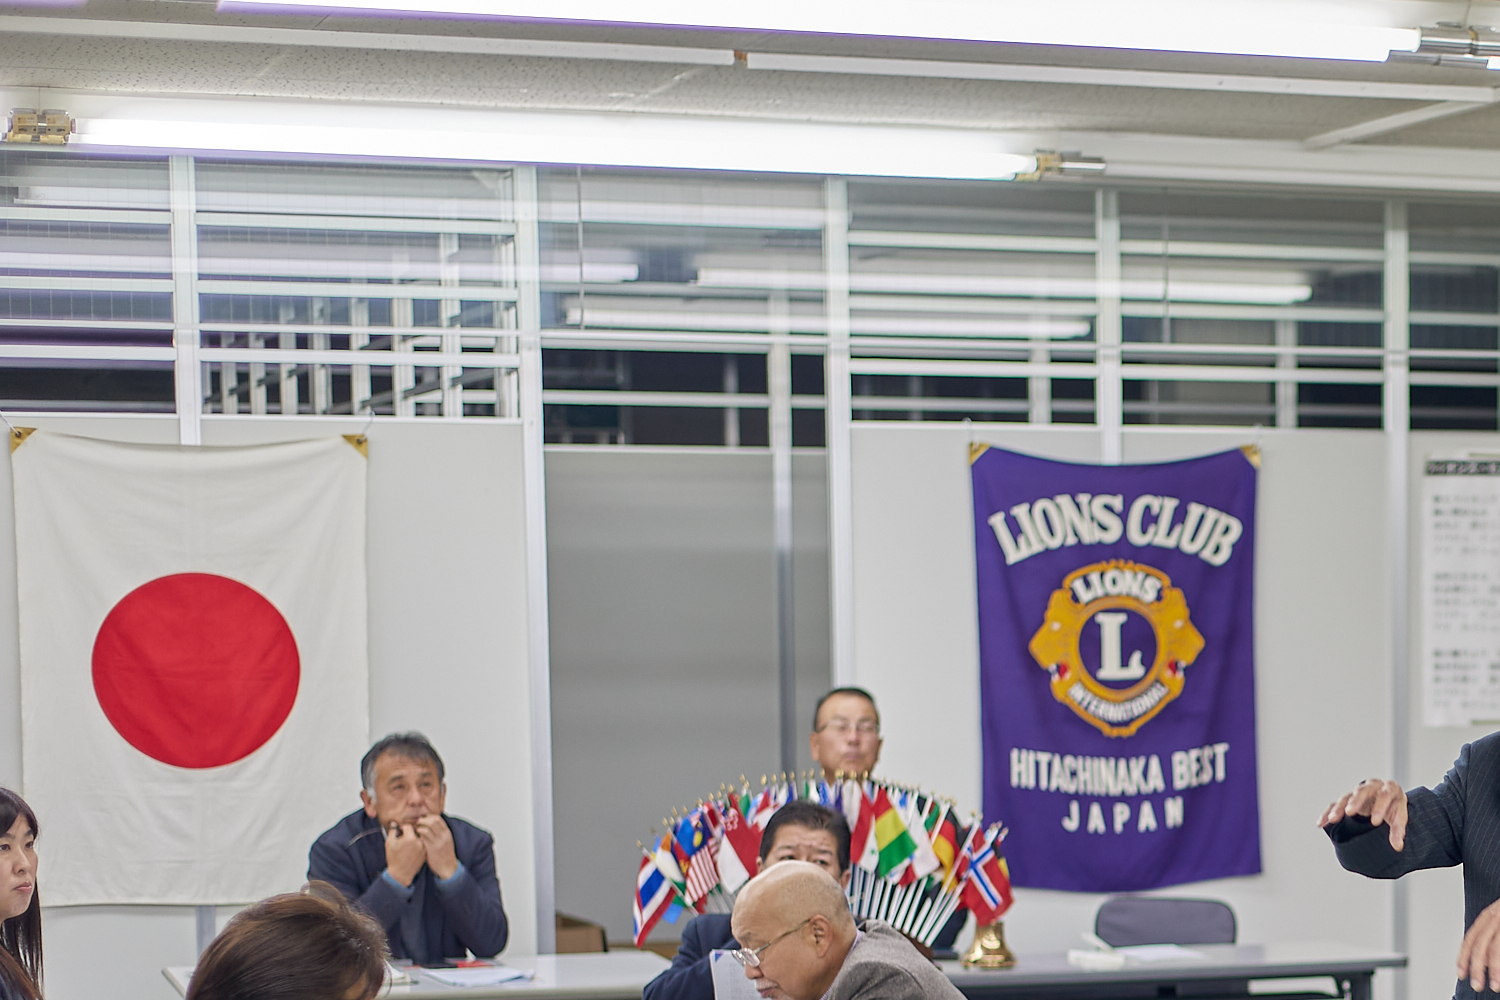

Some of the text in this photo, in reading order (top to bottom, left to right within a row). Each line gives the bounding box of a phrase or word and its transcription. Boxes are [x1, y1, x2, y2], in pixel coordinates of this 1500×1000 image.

[988, 493, 1243, 567] LIONS CLUB
[1071, 569, 1162, 603] LIONS
[1095, 612, 1145, 680] L
[1067, 682, 1169, 723] INTERNATIONAL
[1010, 743, 1230, 797] HITACHINAKA BEST
[1062, 796, 1185, 834] JAPAN
